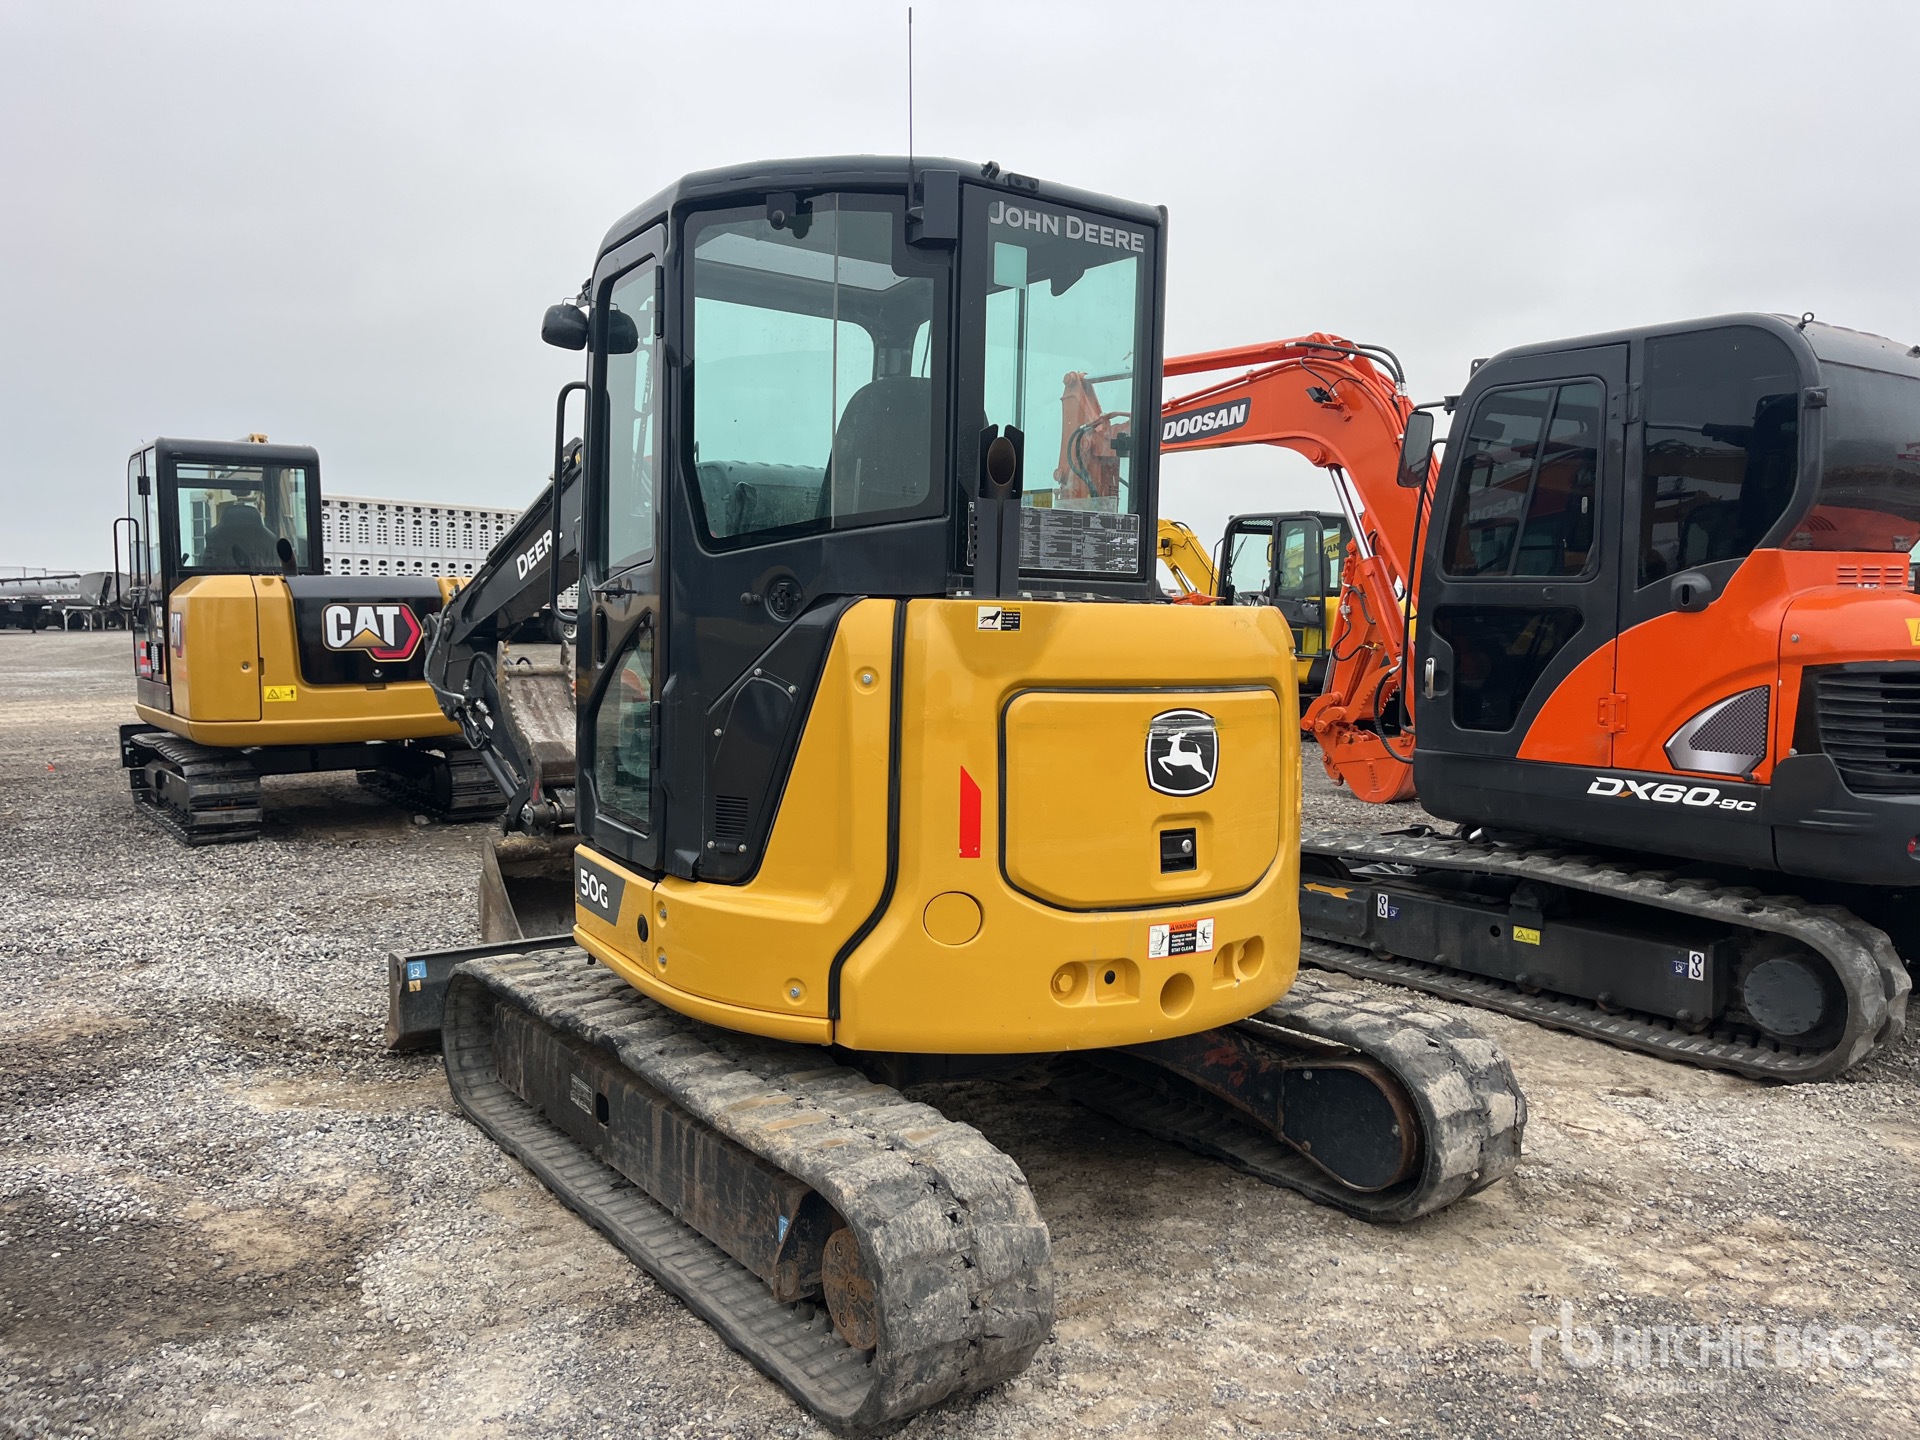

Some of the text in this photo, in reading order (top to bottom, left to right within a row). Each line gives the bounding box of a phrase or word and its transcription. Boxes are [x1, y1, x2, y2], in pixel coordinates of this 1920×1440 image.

[990, 201, 1145, 253] JOHN DEERE
[1162, 404, 1247, 440] DOOSAN
[516, 530, 563, 580] DEER
[326, 605, 400, 648] CAT
[1587, 777, 1757, 811] DX60-9C
[580, 868, 609, 909] 50G
[1175, 921, 1197, 931] WARNING
